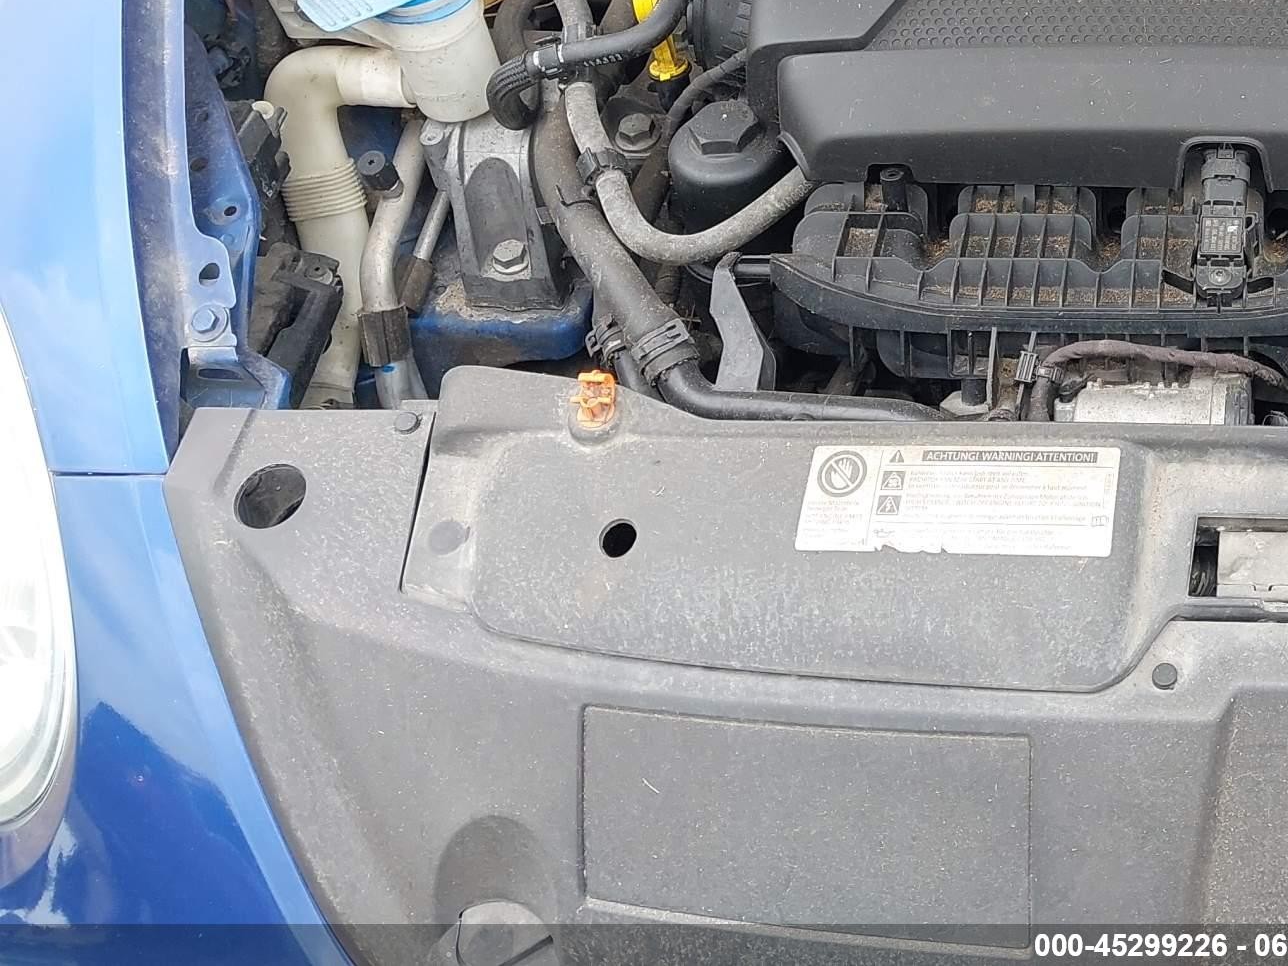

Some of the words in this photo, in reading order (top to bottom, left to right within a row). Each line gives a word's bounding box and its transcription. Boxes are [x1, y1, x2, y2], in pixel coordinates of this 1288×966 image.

[926, 450, 979, 461] ACHTUNG!
[980, 451, 1034, 462] WARNING!
[1036, 452, 1095, 463] ATTENTION!
